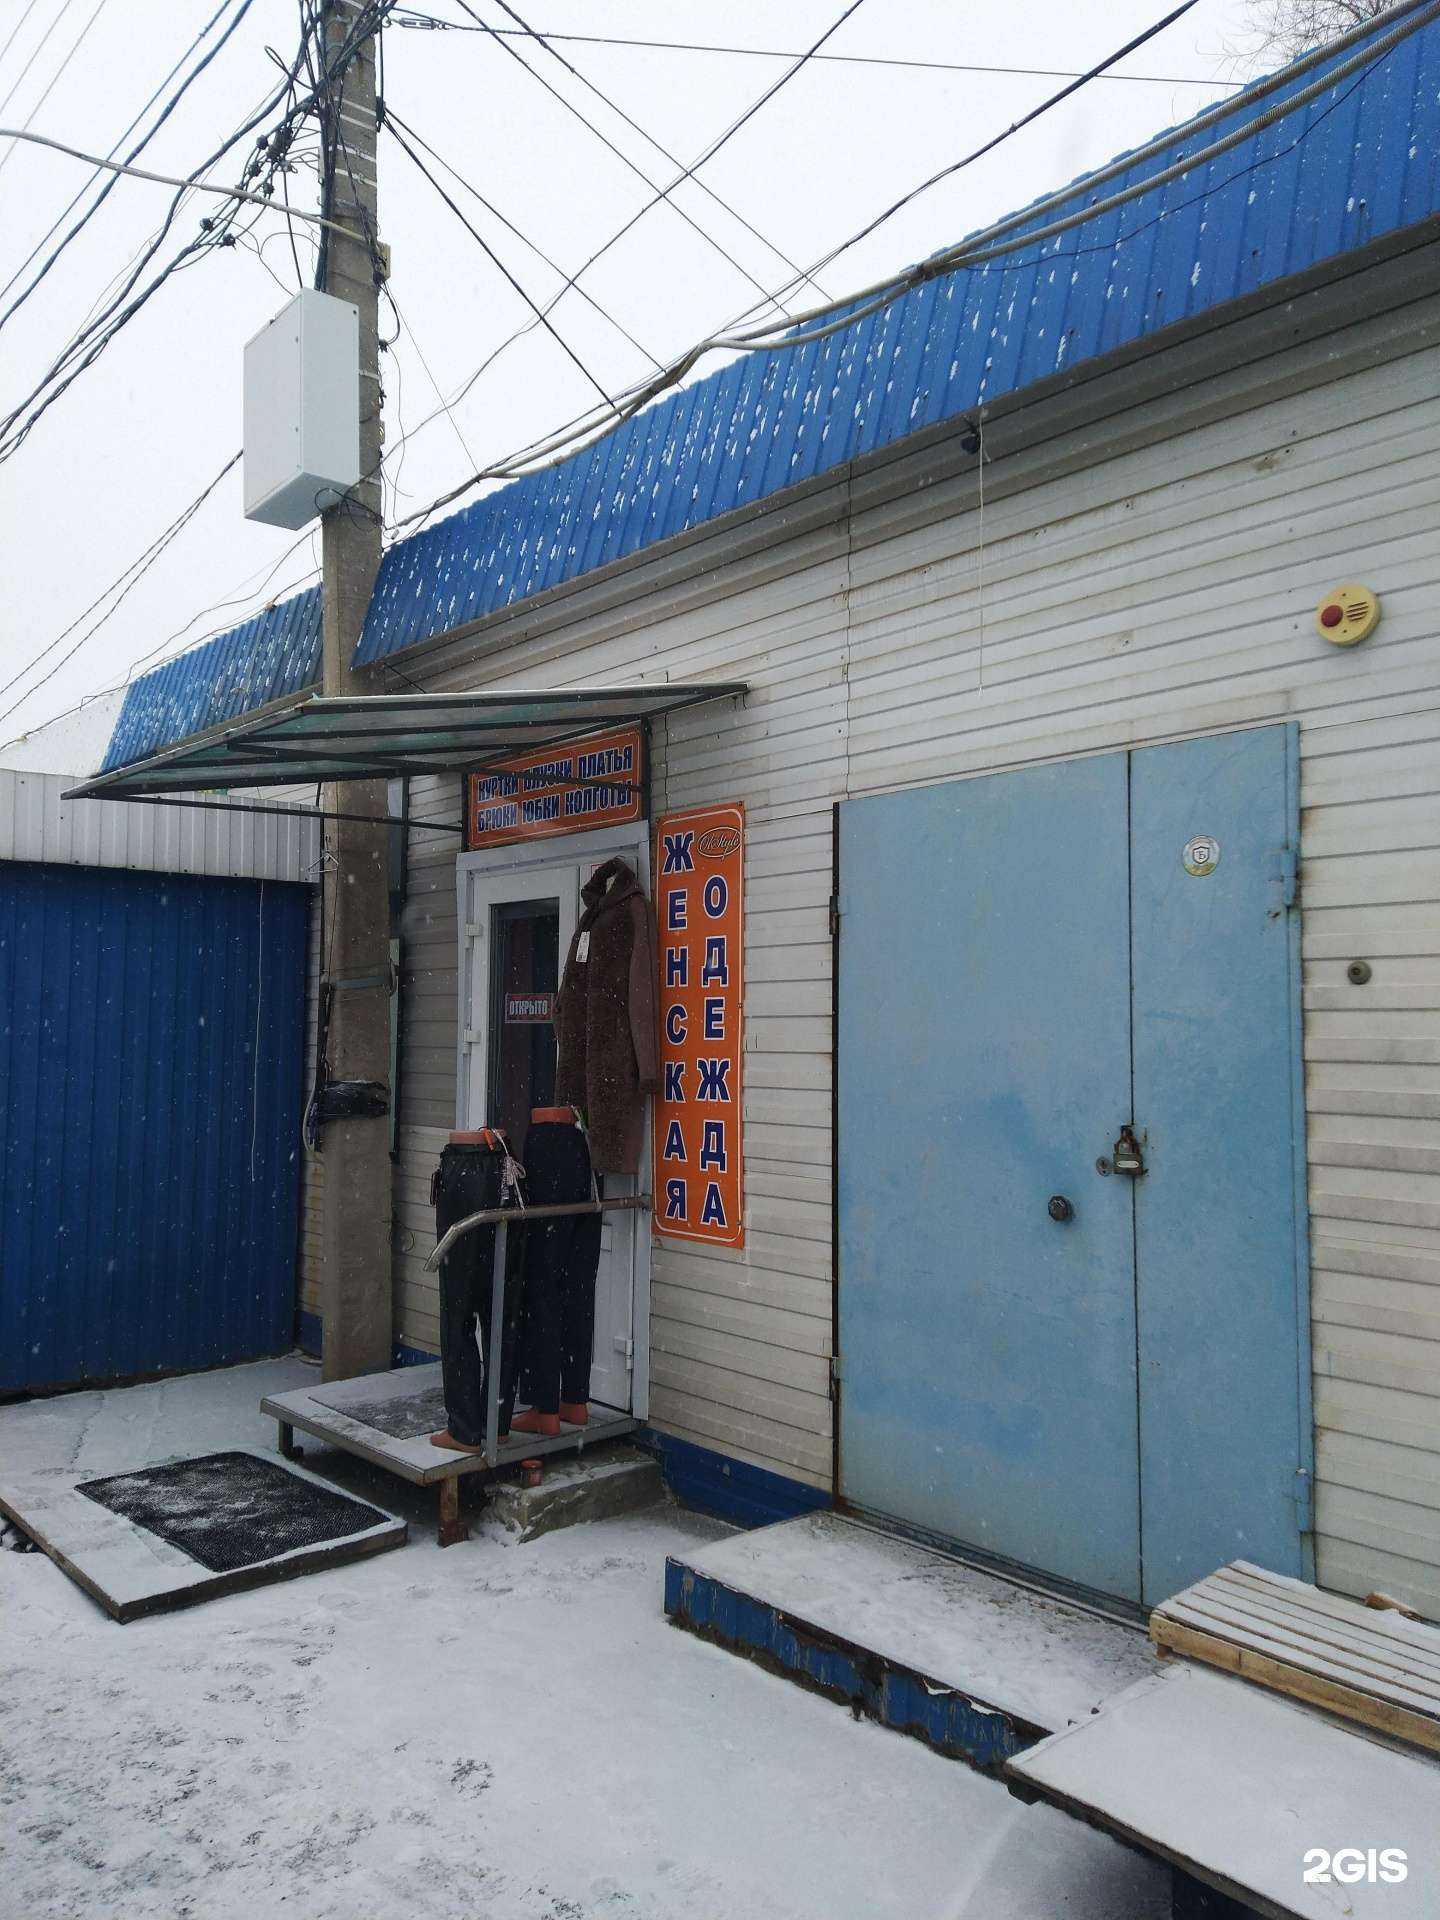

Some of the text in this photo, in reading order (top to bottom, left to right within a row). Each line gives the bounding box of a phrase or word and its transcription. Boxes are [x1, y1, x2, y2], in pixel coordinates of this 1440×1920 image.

[477, 775, 519, 803] КУРТКИ
[577, 744, 634, 779] ПЛАТЬЯ
[477, 802, 518, 833] БРЮКИ
[522, 794, 560, 824] ЮБКИ
[509, 1000, 548, 1016] ОТКРЫТО
[662, 831, 695, 1221] ЖЕНСКАЯ
[696, 874, 731, 1228] ОДЕЖДА
